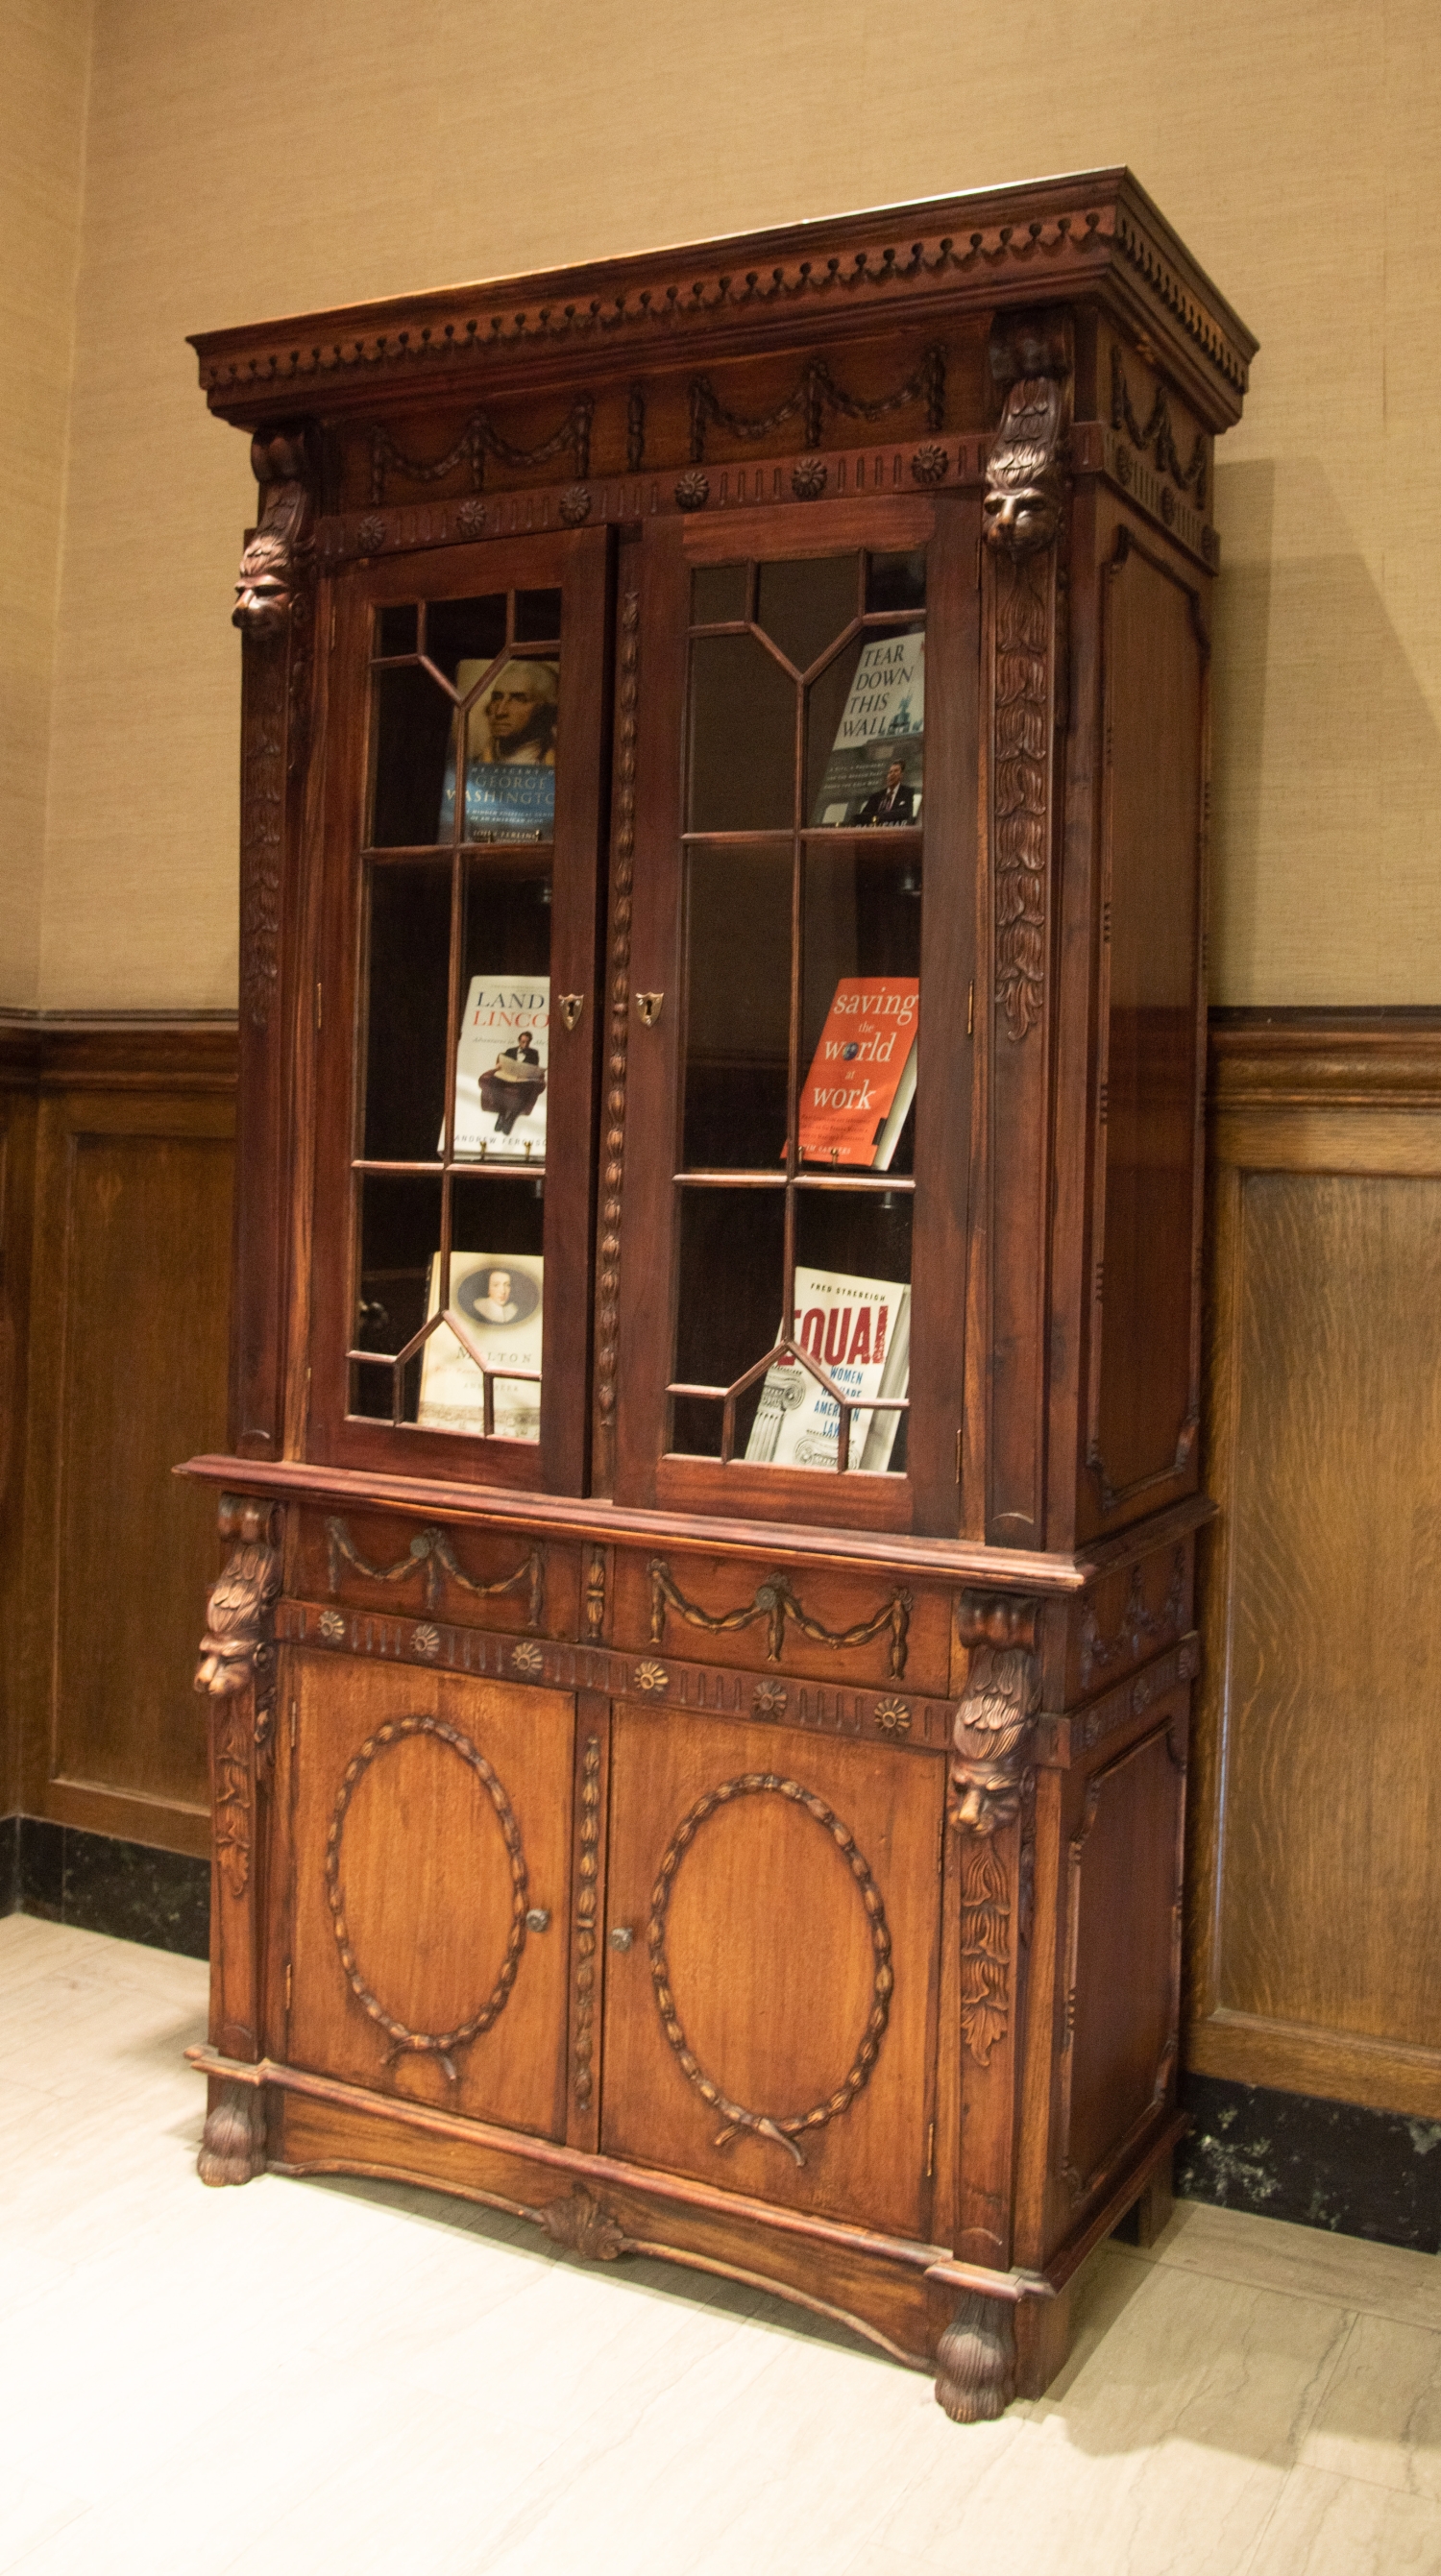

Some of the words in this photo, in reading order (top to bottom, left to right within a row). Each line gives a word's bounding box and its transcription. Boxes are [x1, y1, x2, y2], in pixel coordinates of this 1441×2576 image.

[864, 644, 904, 668] TEAR
[856, 666, 914, 691] DOWN
[849, 692, 890, 714] THIS
[843, 716, 886, 738] WALL
[476, 775, 547, 790] GEORGE
[476, 991, 545, 1009] LAND
[834, 986, 919, 1026] saving
[473, 1009, 550, 1029] LINCO
[859, 1021, 874, 1033] the
[824, 1032, 896, 1062] world
[845, 1070, 855, 1081] at
[814, 1080, 876, 1110] work
[811, 1283, 832, 1293] FRED
[836, 1288, 886, 1302] STREBEIGH
[456, 1347, 531, 1363] MLTON
[830, 1366, 863, 1385] WOMEN
